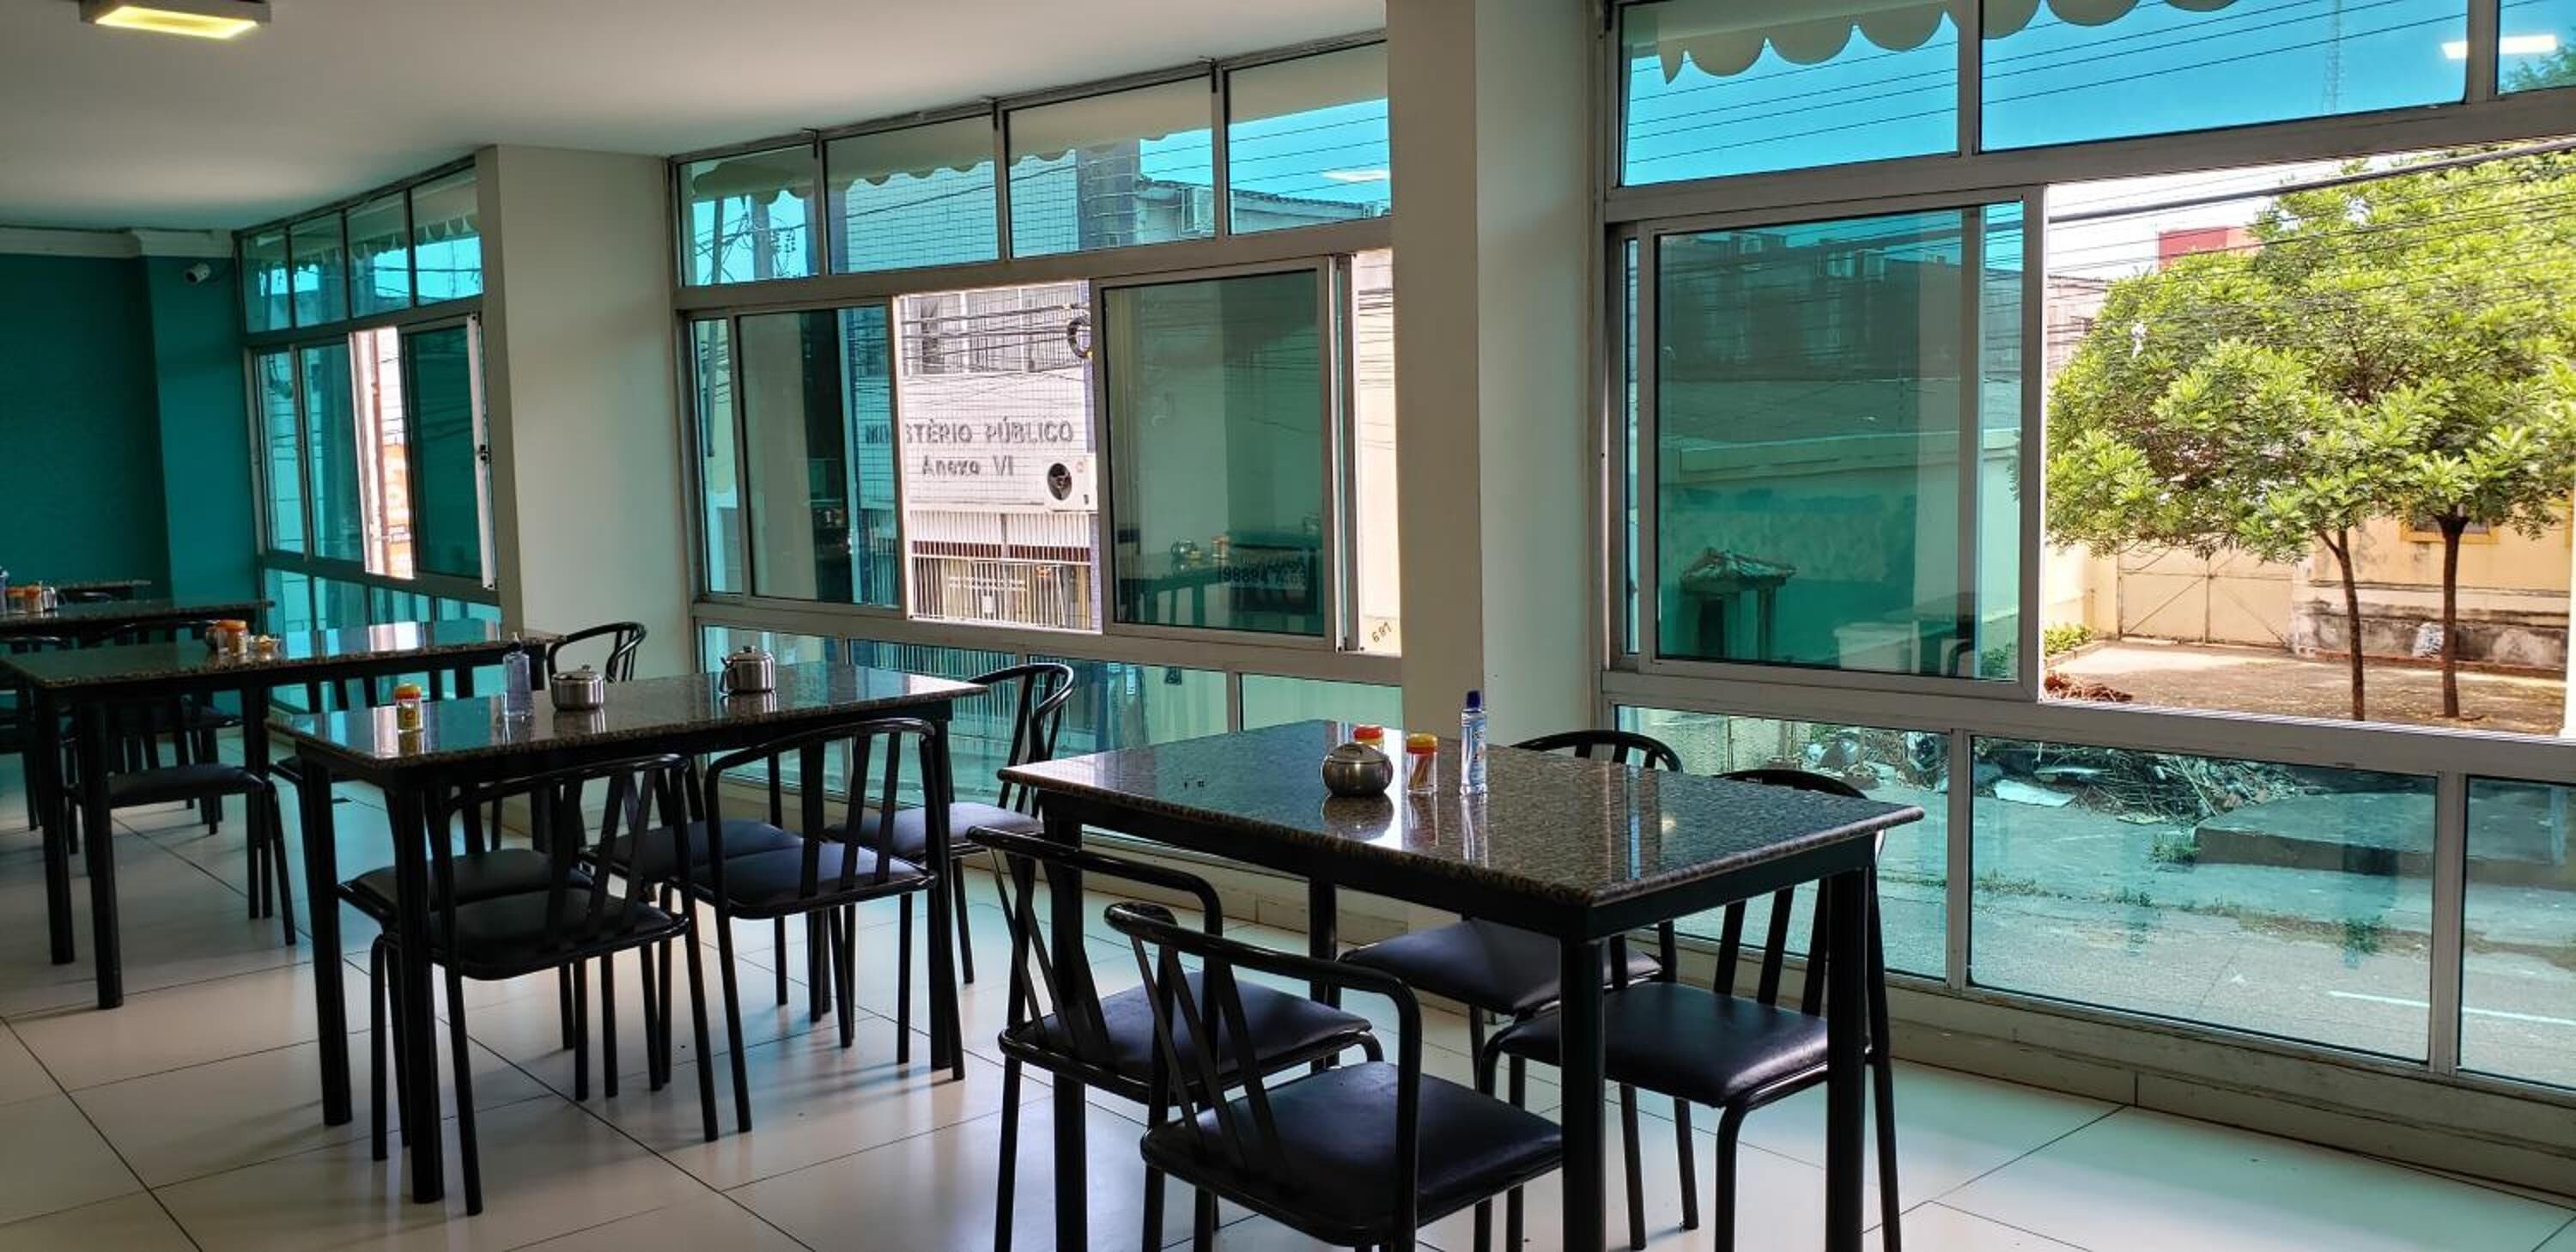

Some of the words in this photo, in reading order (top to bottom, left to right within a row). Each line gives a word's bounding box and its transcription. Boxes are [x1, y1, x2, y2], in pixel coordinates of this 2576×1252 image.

[866, 417, 972, 443] MINSTÉRIO
[986, 416, 1072, 443] PÚBLICO
[922, 454, 981, 476] Anexo
[993, 455, 1013, 476] VI
